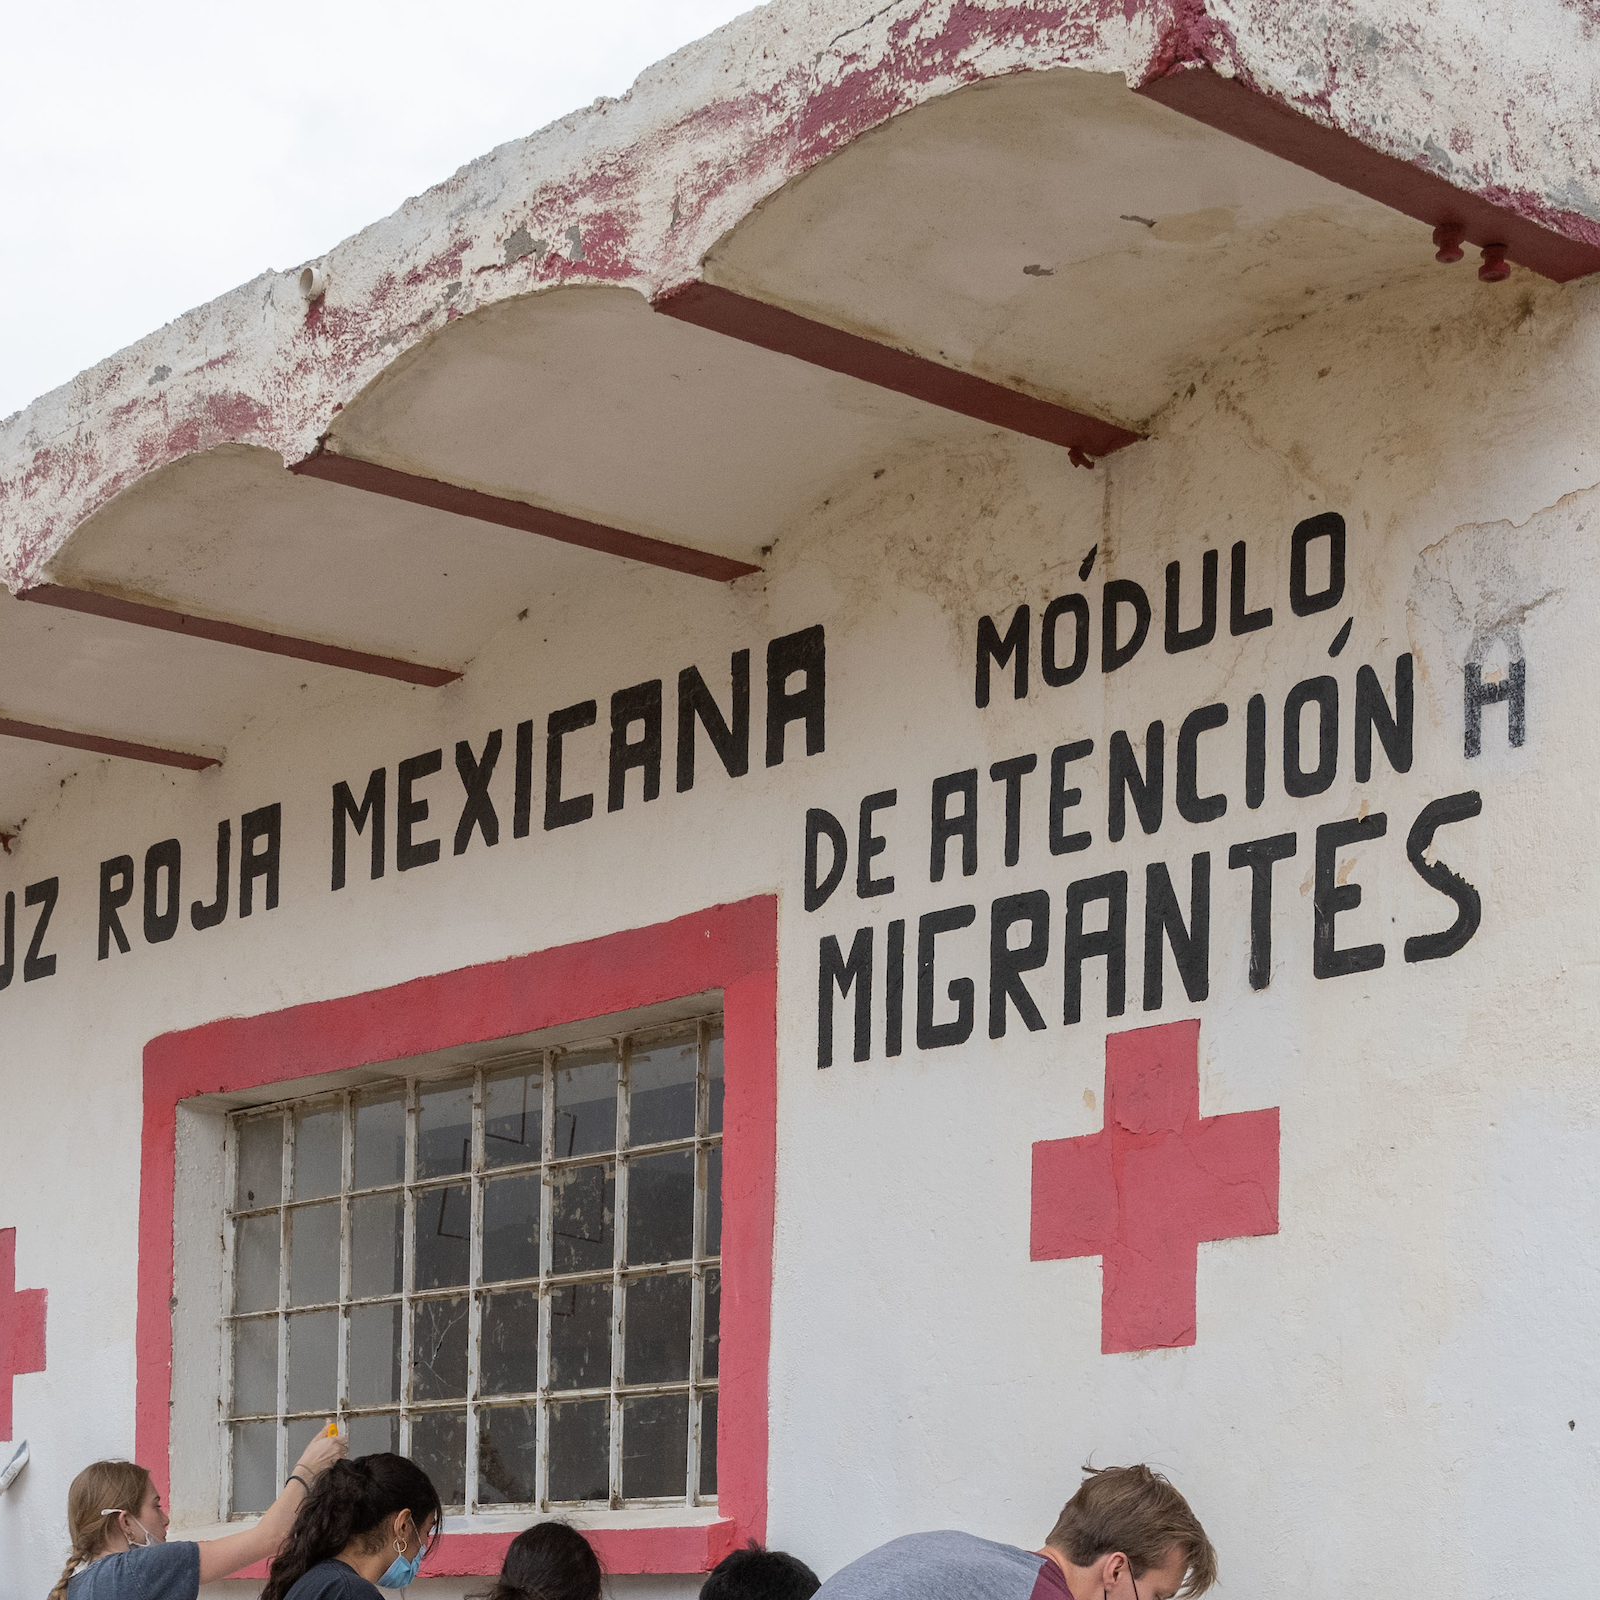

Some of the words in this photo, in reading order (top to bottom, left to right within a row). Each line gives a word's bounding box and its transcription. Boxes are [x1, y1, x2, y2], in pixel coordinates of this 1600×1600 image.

[973, 511, 1348, 709] MÓDULO
[97, 801, 282, 961] ROJA
[330, 623, 826, 892] MEXICANA
[804, 788, 898, 913] DE
[929, 617, 1414, 883] ATENCIÓN
[817, 789, 1483, 1070] MIGRANTES
